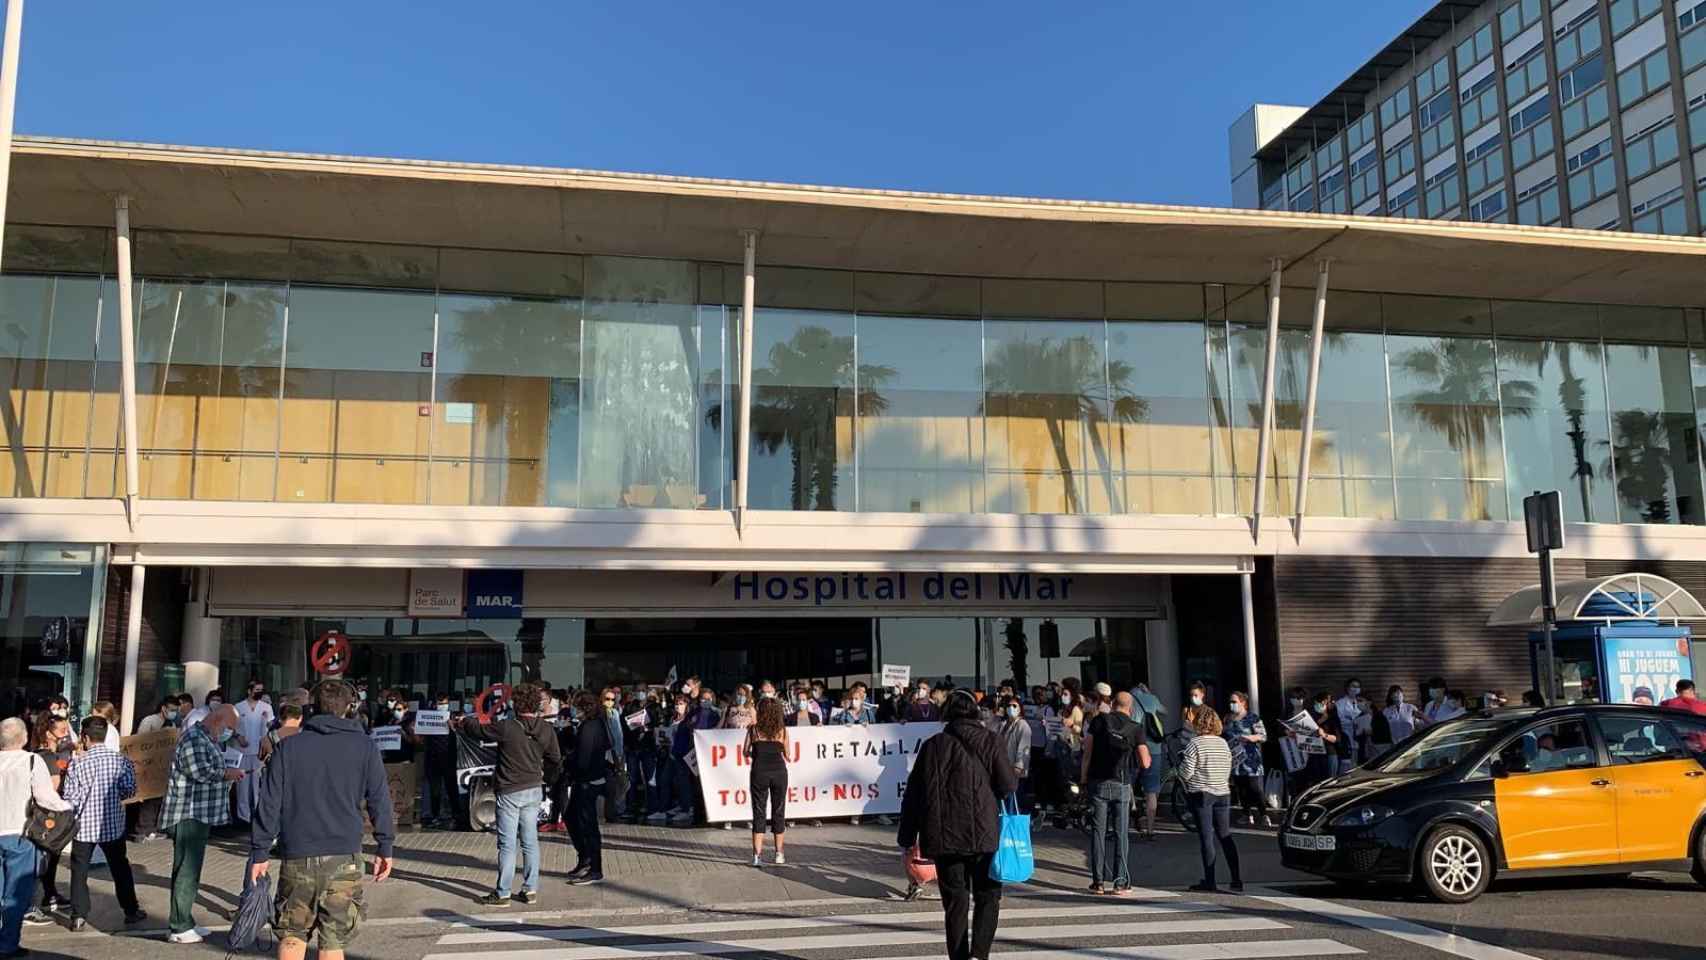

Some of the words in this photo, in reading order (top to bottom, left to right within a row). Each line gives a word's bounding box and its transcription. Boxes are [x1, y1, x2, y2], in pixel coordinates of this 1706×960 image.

[733, 572, 906, 605] Hospital
[923, 572, 982, 601] del
[1000, 572, 1074, 601] Mar
[431, 597, 457, 606] Salut
